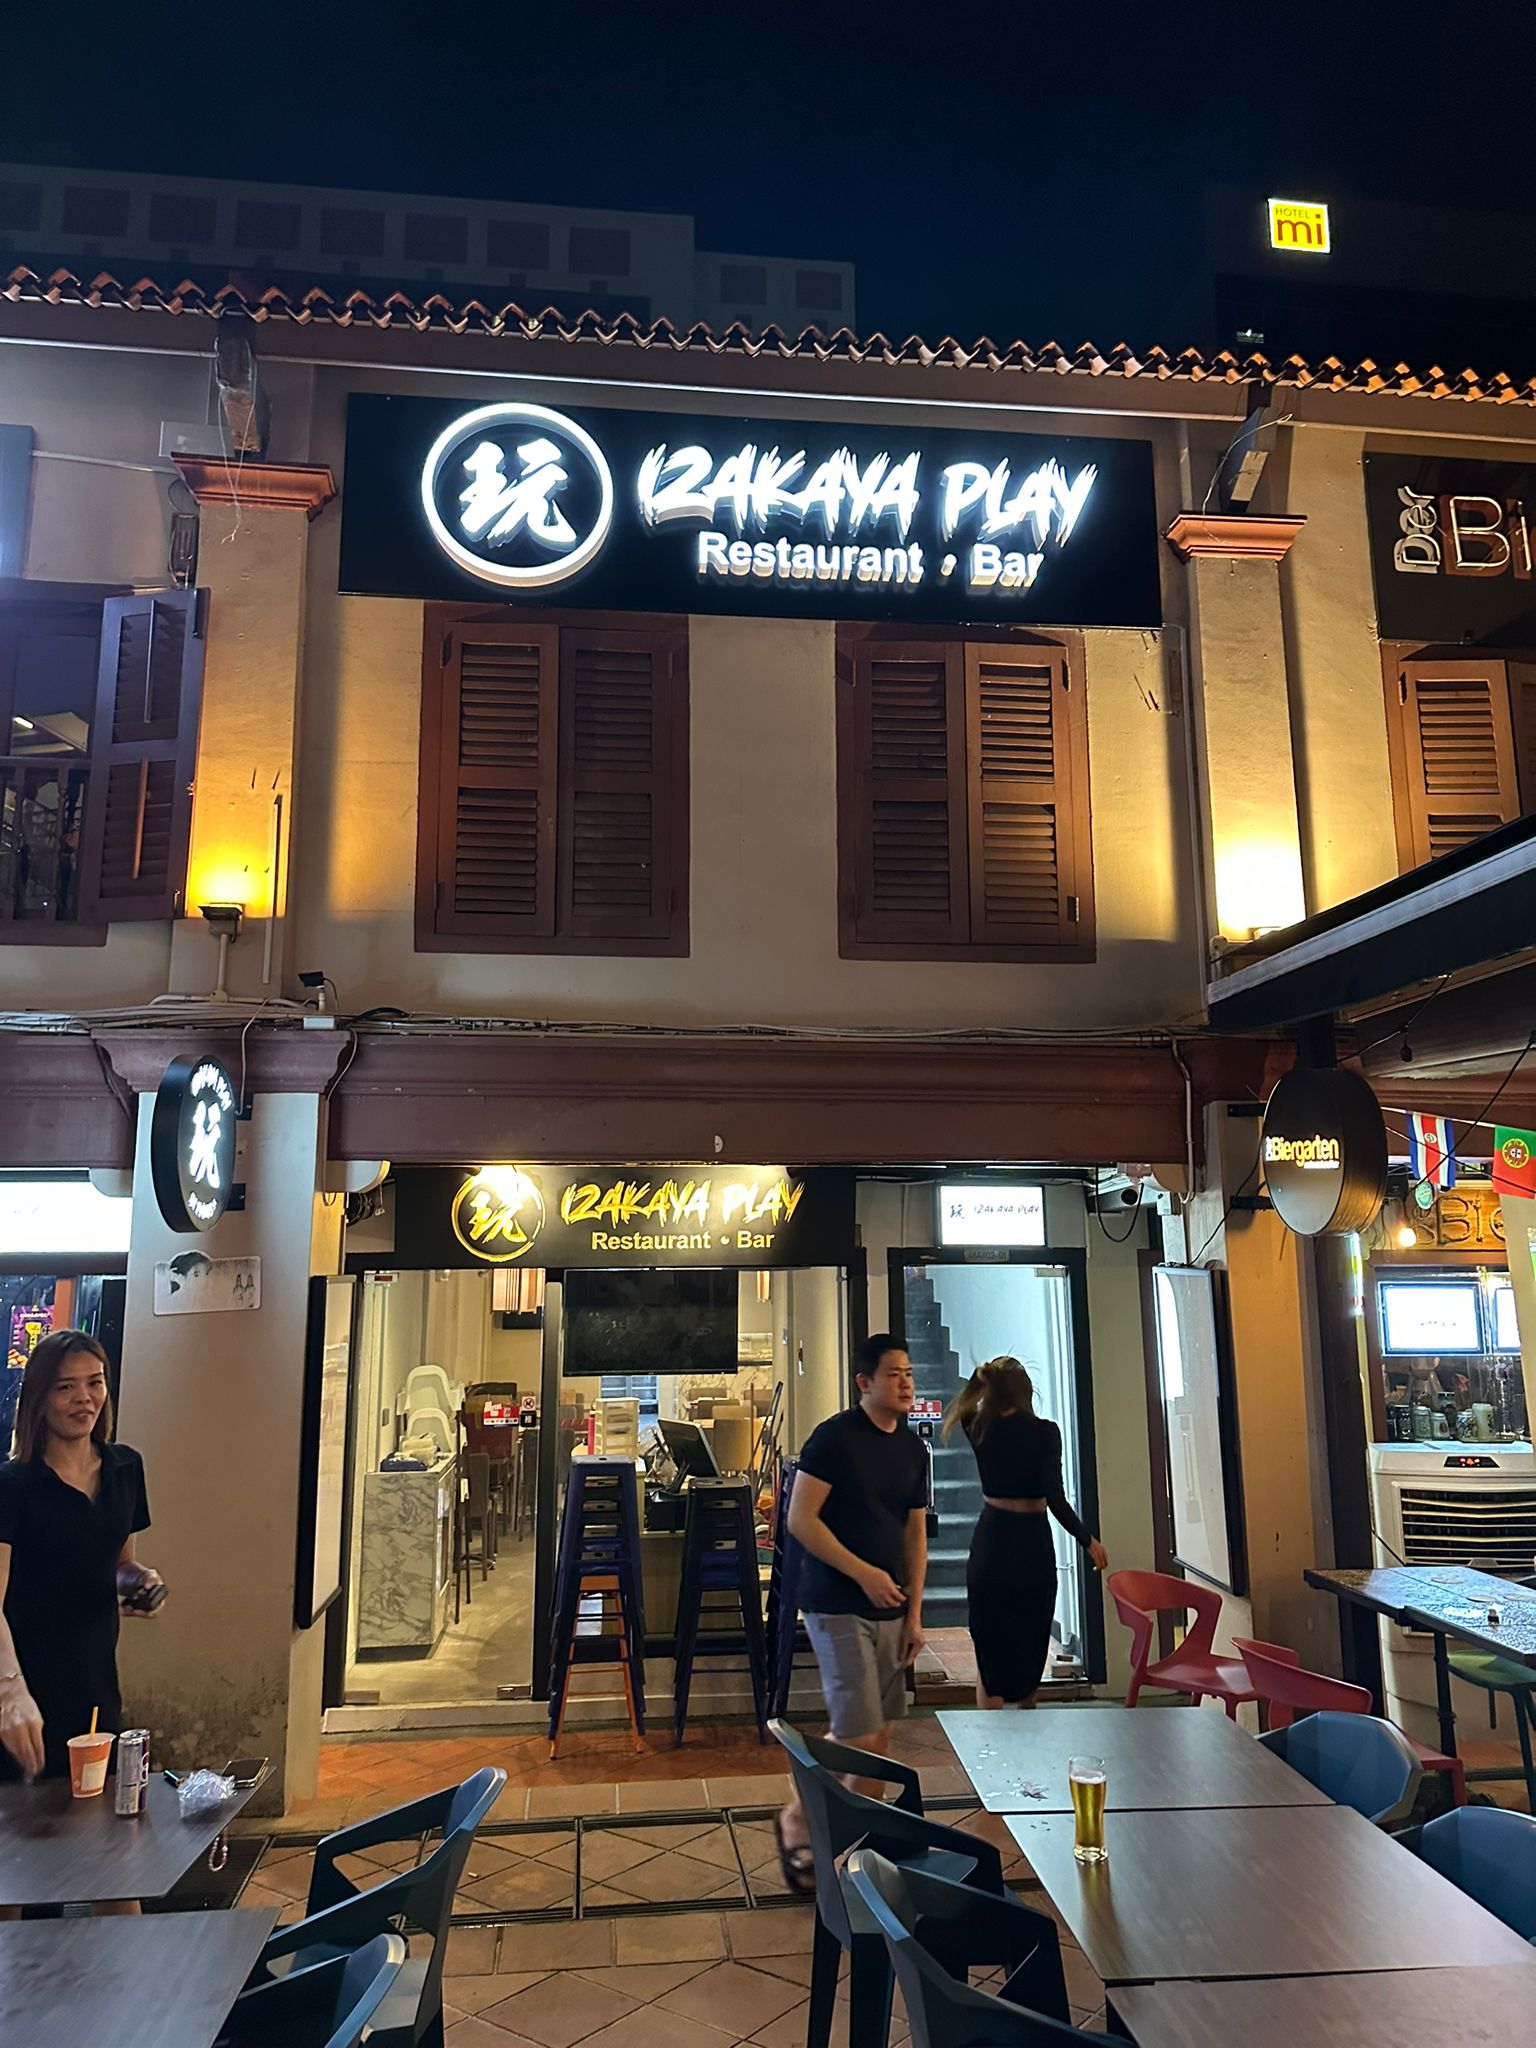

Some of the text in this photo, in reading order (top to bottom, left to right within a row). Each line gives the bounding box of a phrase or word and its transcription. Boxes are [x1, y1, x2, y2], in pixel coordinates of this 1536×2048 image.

[1275, 207, 1311, 219] HOTEL
[1277, 213, 1323, 245] mi
[458, 437, 577, 546] 玩
[637, 443, 1099, 548] IZAKAYA PLAY
[1394, 485, 1536, 579] Der Bi
[697, 530, 1046, 587] Restaurant Bar
[1271, 1134, 1340, 1168] Biergarten
[469, 1187, 528, 1244] 玩
[561, 1179, 806, 1229] IZAKAYA PLAY
[1017, 1203, 1040, 1216] PLAY
[591, 1230, 775, 1250] Restaurant Bar
